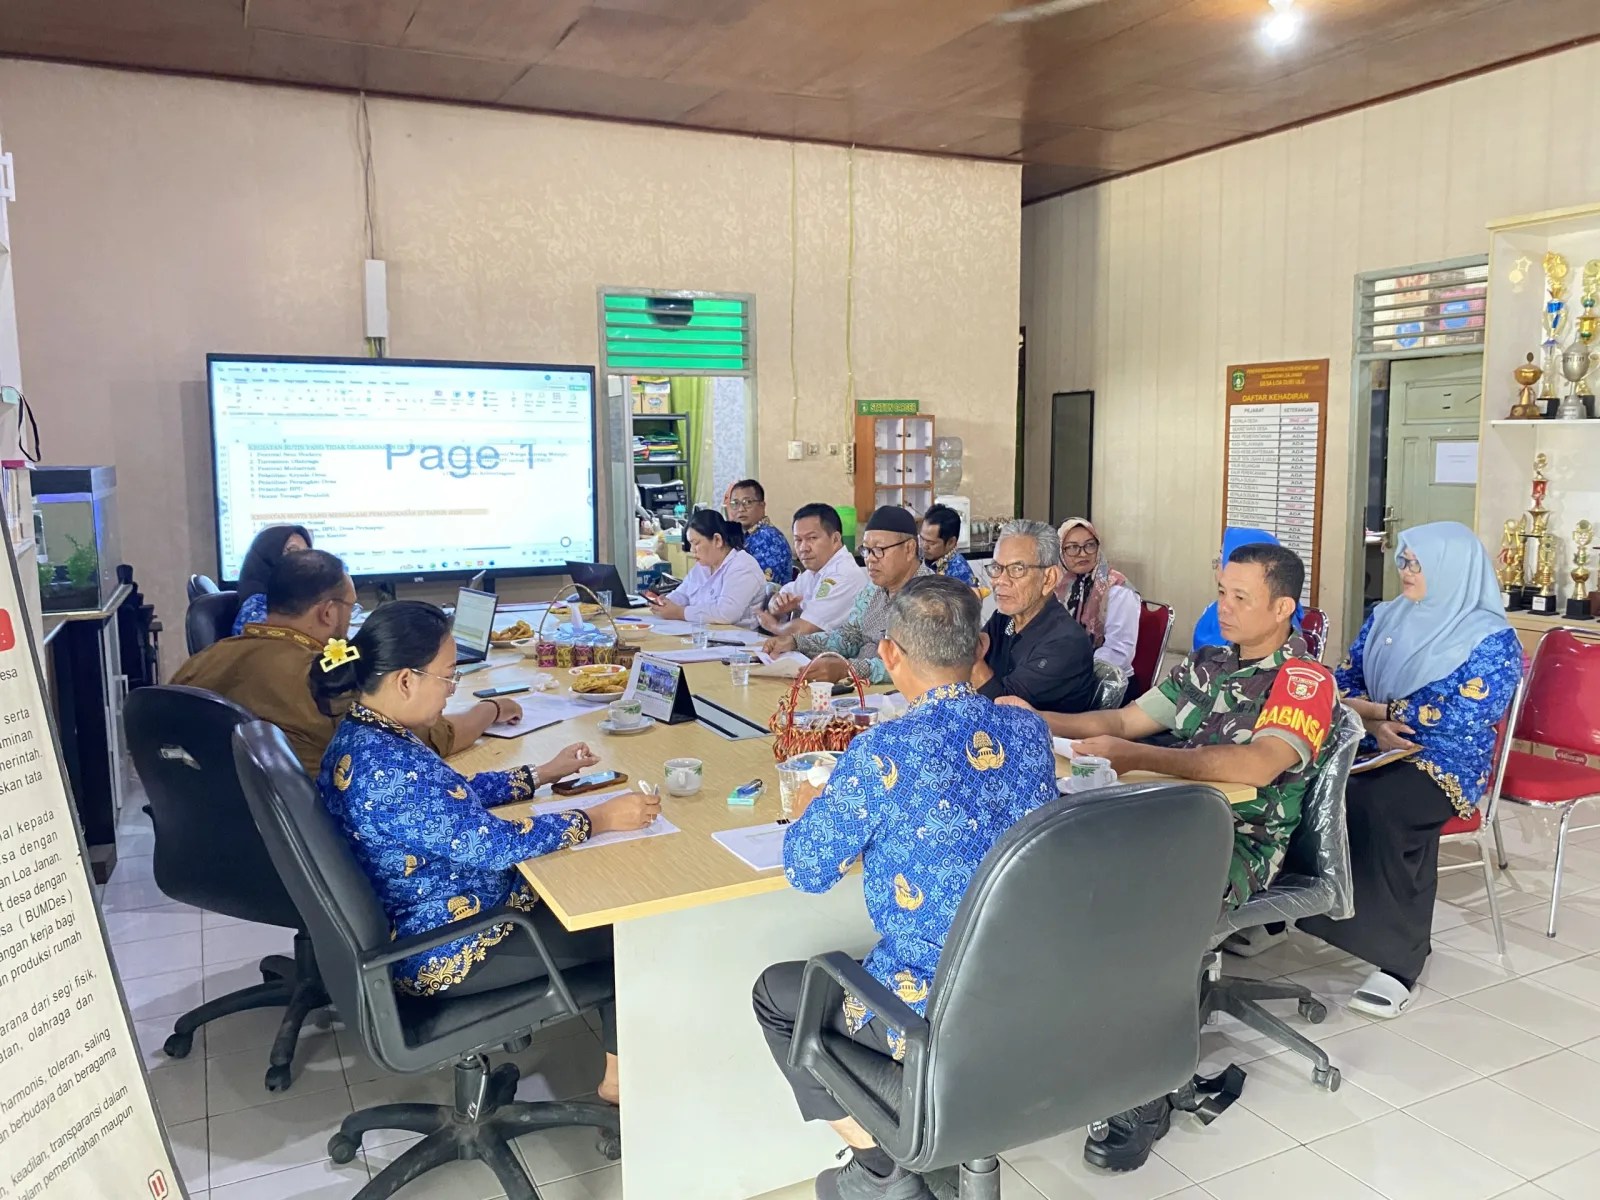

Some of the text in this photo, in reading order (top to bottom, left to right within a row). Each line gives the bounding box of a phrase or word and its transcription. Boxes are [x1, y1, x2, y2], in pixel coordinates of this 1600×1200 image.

[1242, 392, 1309, 402] DAFTAR KEHADIRAN
[386, 443, 534, 479] Page 1
[4, 708, 31, 725] serta
[1254, 705, 1325, 754] BABINSA
[0, 729, 34, 749] minan
[24, 770, 43, 785] tata
[16, 809, 55, 834] kepada
[19, 831, 59, 856] dengan
[12, 866, 32, 883] Loa
[33, 852, 62, 873] Janan.
[6, 889, 32, 909] desa
[33, 871, 68, 896] dengan
[30, 924, 54, 945] kerja
[55, 909, 76, 930] bagi
[10, 945, 52, 983] produksi
[53, 930, 83, 955] rumah
[30, 994, 51, 1016] dari
[52, 980, 74, 1002] segi
[74, 968, 97, 989] fisik,
[28, 1007, 71, 1042] olahraga
[75, 993, 94, 1011] dan
[0, 1027, 111, 1114] harmonis, toleran, saling
[9, 1092, 56, 1134] berbudaya
[56, 1078, 75, 1097] dan
[74, 1046, 118, 1083] beragama
[10, 1151, 51, 1187] keadilan,
[49, 1104, 103, 1153] transparansi
[103, 1084, 129, 1111] dalam
[43, 1132, 101, 1191] pemerintahan
[100, 1104, 134, 1138] maupun
